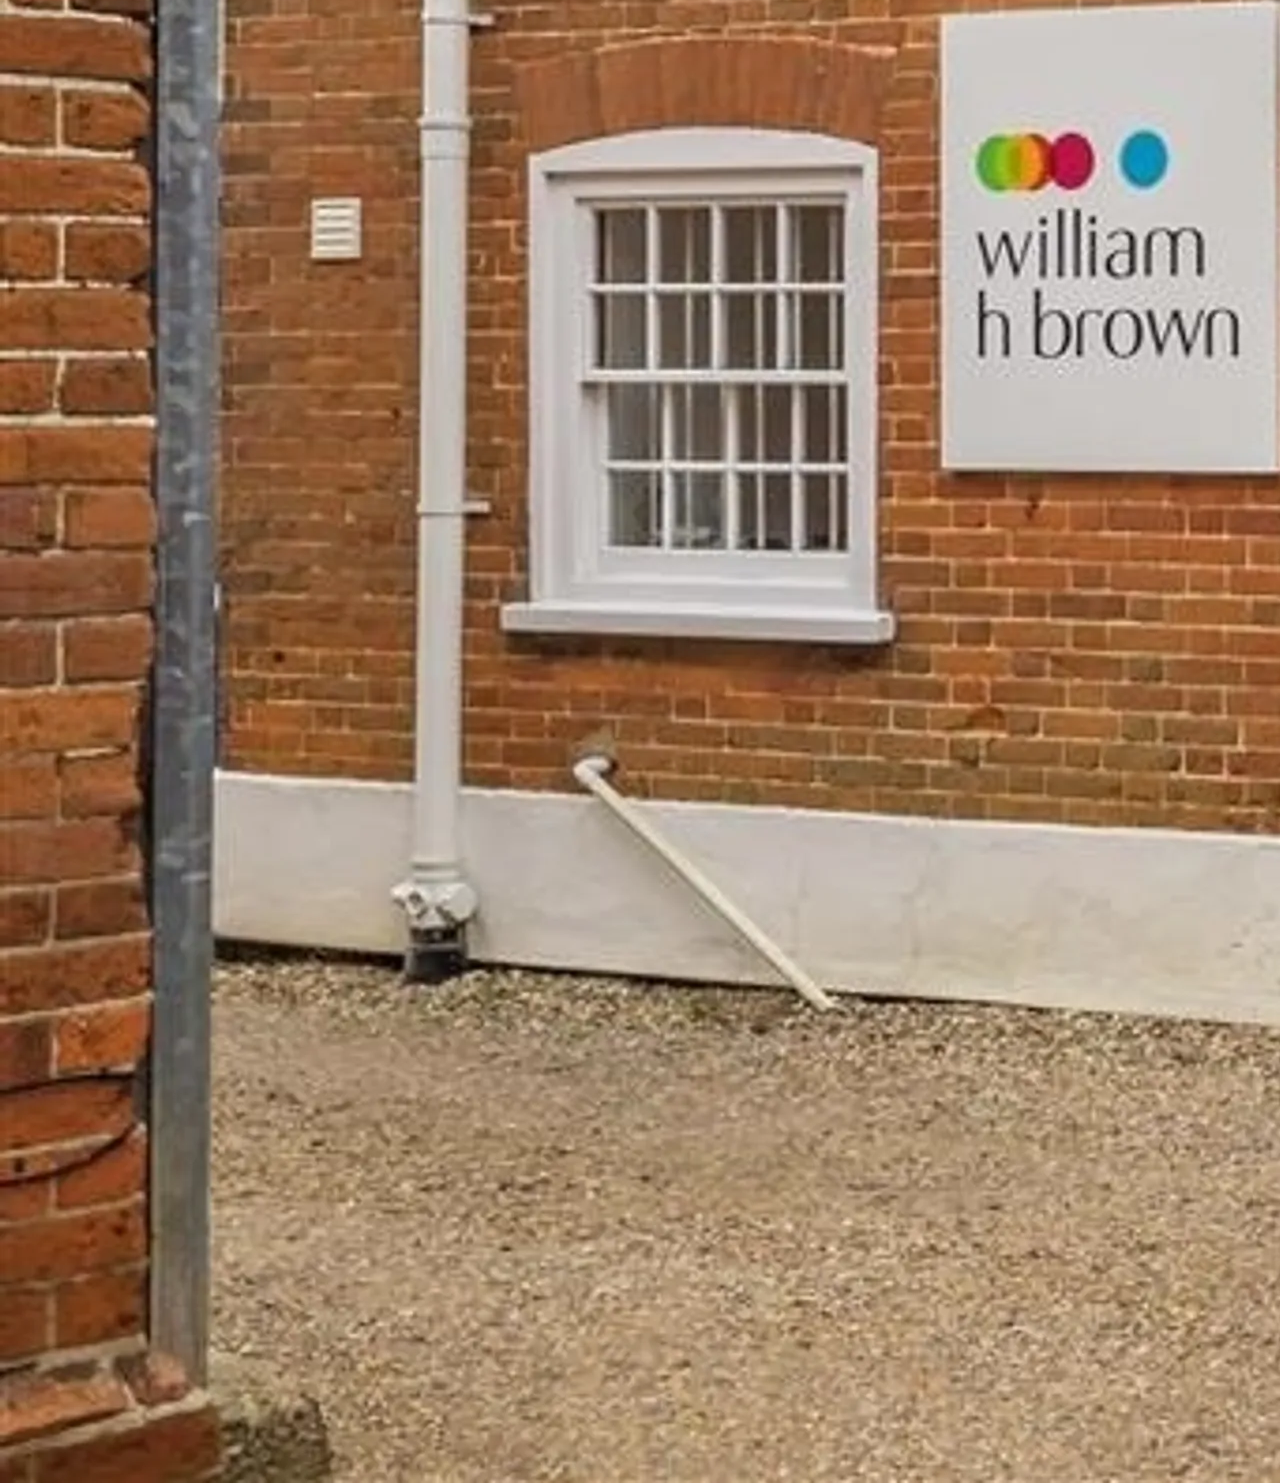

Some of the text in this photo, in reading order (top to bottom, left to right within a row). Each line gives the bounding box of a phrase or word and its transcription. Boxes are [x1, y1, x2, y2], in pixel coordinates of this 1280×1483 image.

[976, 208, 1205, 279] william
[977, 288, 1240, 359] h brown
